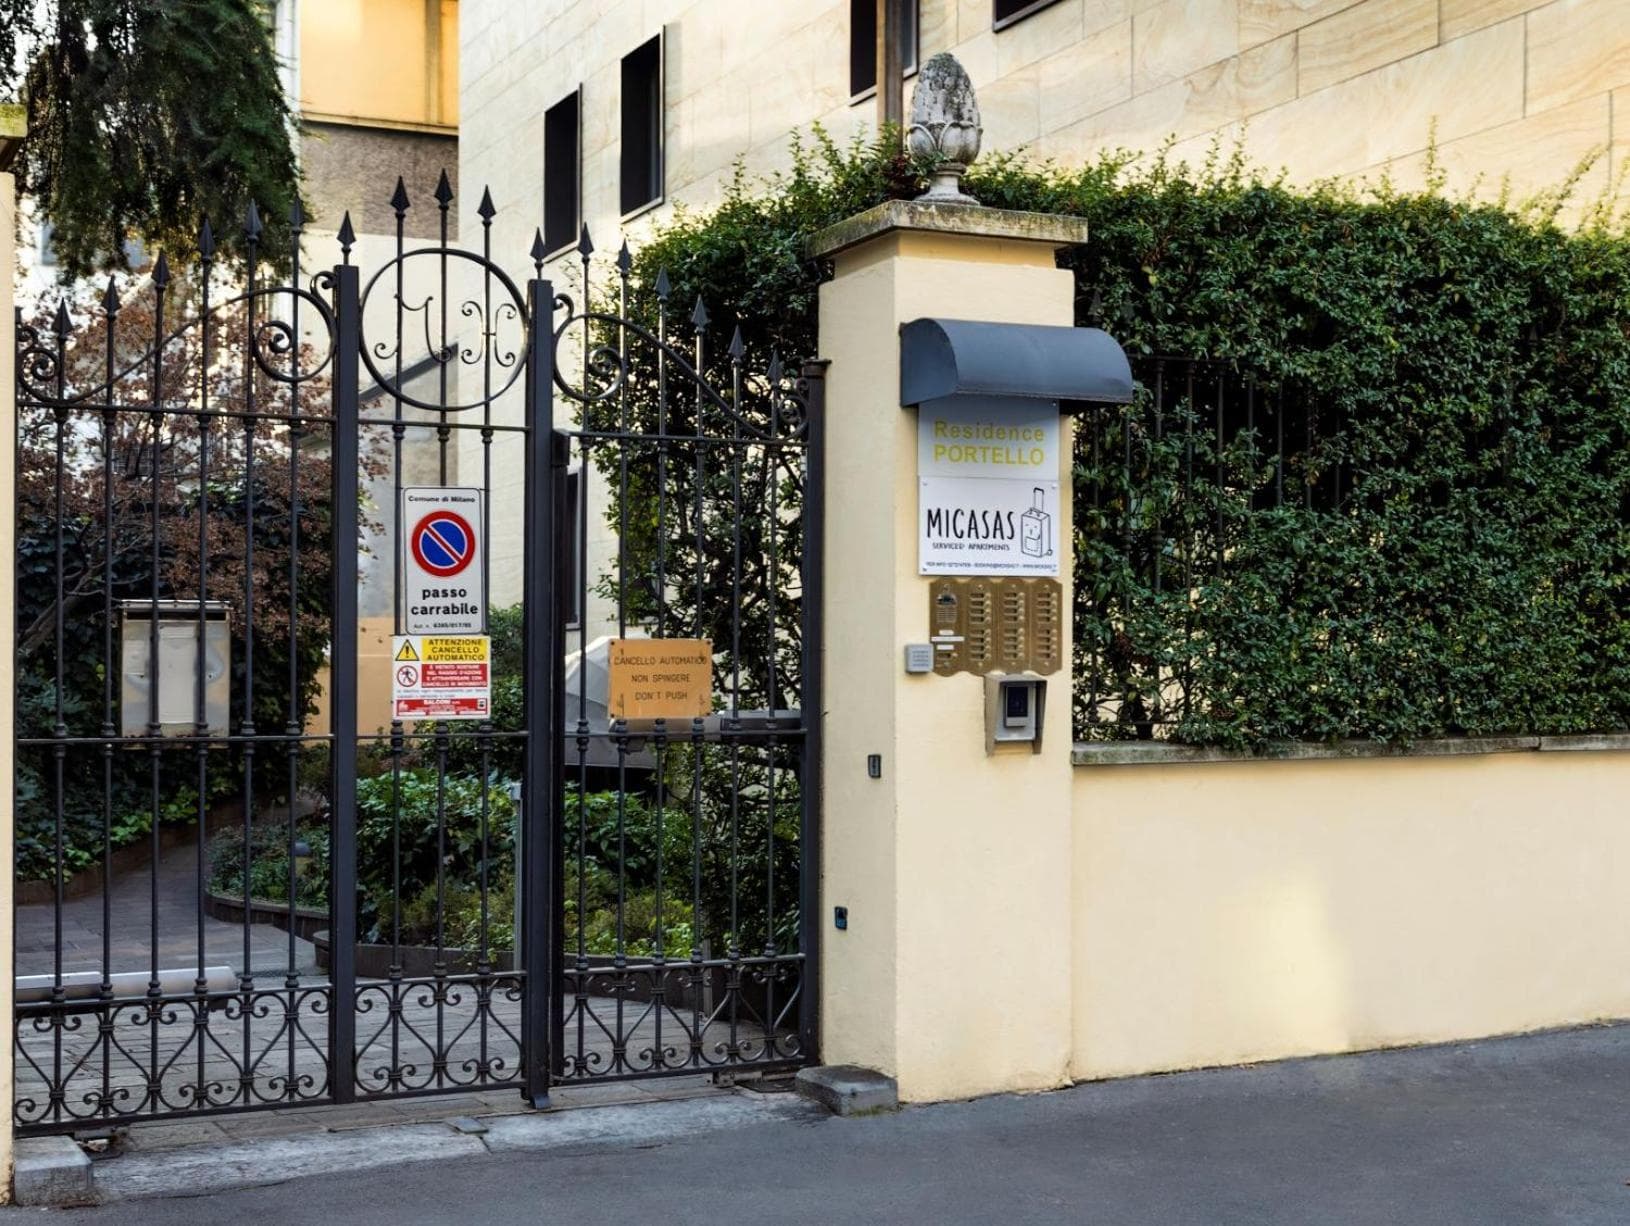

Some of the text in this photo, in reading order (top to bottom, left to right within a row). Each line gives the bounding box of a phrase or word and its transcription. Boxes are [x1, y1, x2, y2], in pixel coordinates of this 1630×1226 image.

[934, 420, 1045, 442] Residence
[934, 444, 1045, 465] PORTELLO
[408, 495, 476, 503] Comune di Milano
[927, 508, 1015, 540] MICASAS
[932, 543, 965, 551] SERVICED
[422, 588, 467, 600] passo
[411, 603, 479, 615] carrabile
[613, 656, 655, 665] CANCELLO
[631, 674, 690, 683] NON SPINGERE
[635, 691, 688, 701] DON'T PUSH
